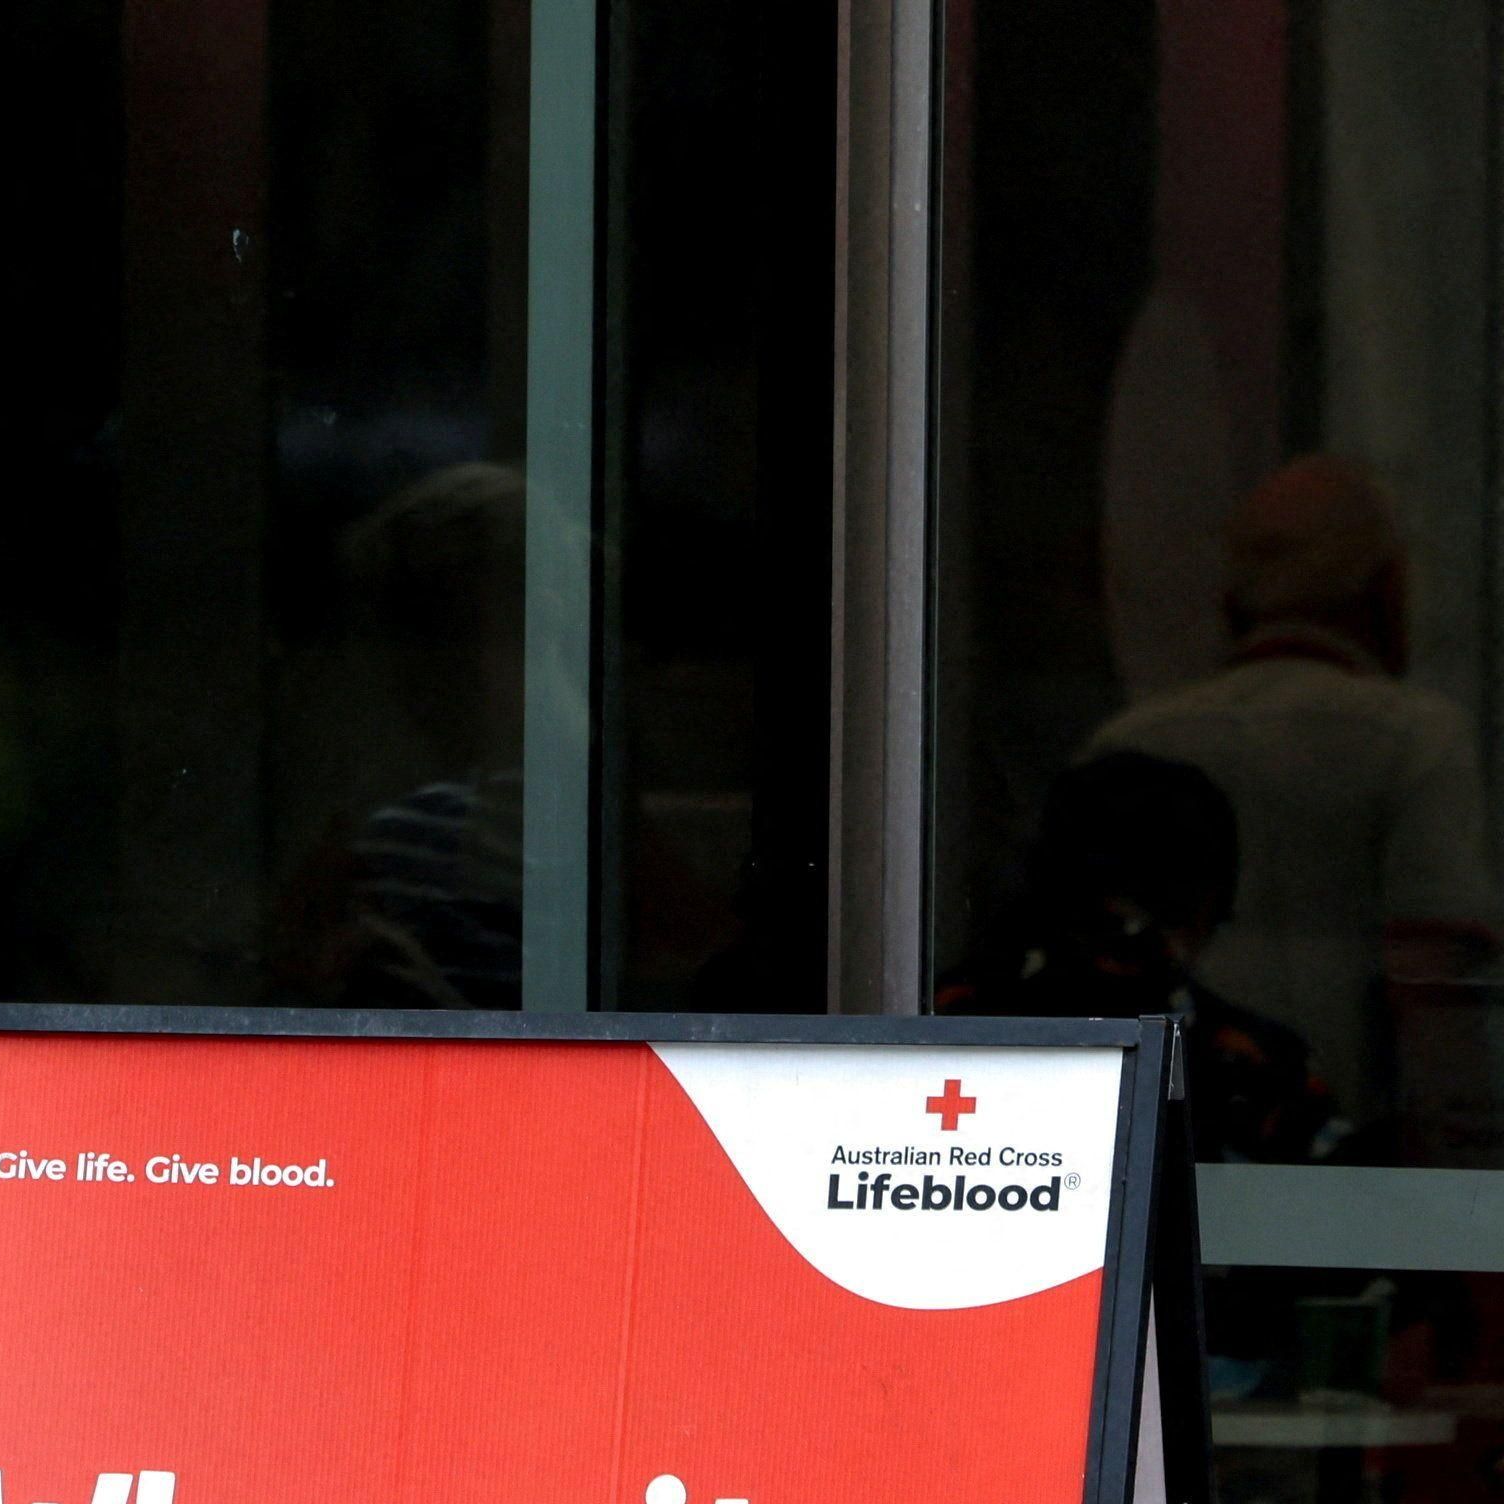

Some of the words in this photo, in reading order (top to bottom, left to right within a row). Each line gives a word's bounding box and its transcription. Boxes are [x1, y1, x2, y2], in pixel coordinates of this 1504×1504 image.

[76, 1151, 135, 1183] life.
[145, 1153, 220, 1185] Give
[229, 1156, 335, 1188] blood.
[831, 1145, 941, 1166] Australian
[949, 1146, 992, 1166] Red
[998, 1146, 1063, 1167] Cross
